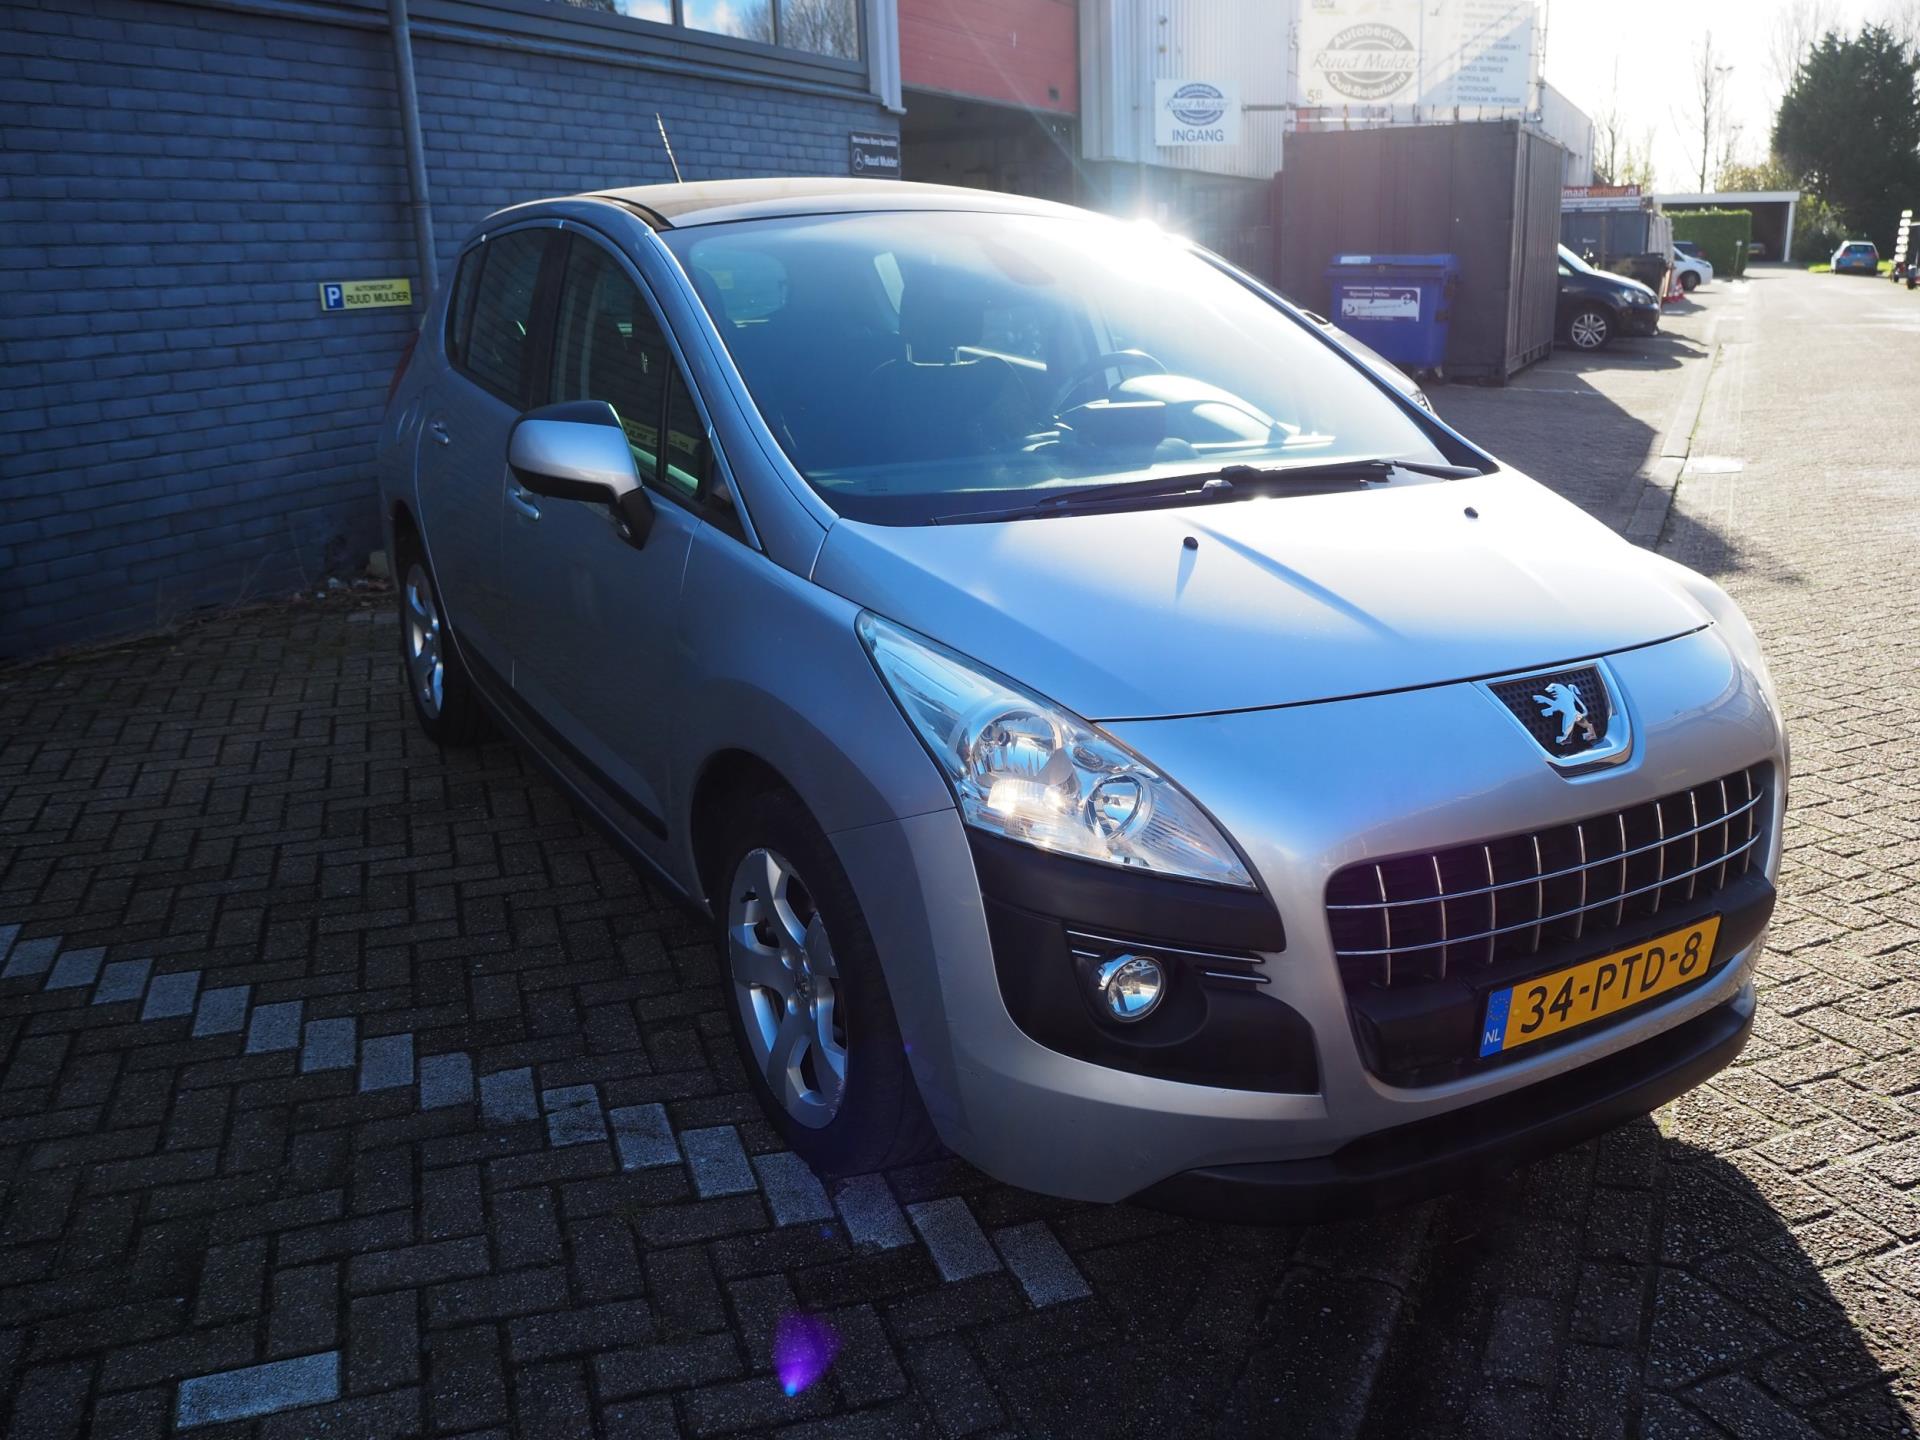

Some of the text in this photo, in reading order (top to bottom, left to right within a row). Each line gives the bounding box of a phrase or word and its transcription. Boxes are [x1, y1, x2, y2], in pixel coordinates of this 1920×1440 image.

[1334, 26, 1407, 48] Autobedrijf
[1312, 51, 1361, 69] Ruud
[1330, 73, 1407, 98] Oud-Beijerland
[1172, 129, 1224, 142] INGANG
[864, 154, 898, 167] Ruud Mulder
[326, 287, 340, 306] P
[346, 291, 409, 304] RUUD MULDER
[1520, 931, 1702, 1033] 34-PTD-8
[1484, 1029, 1501, 1046] NL
